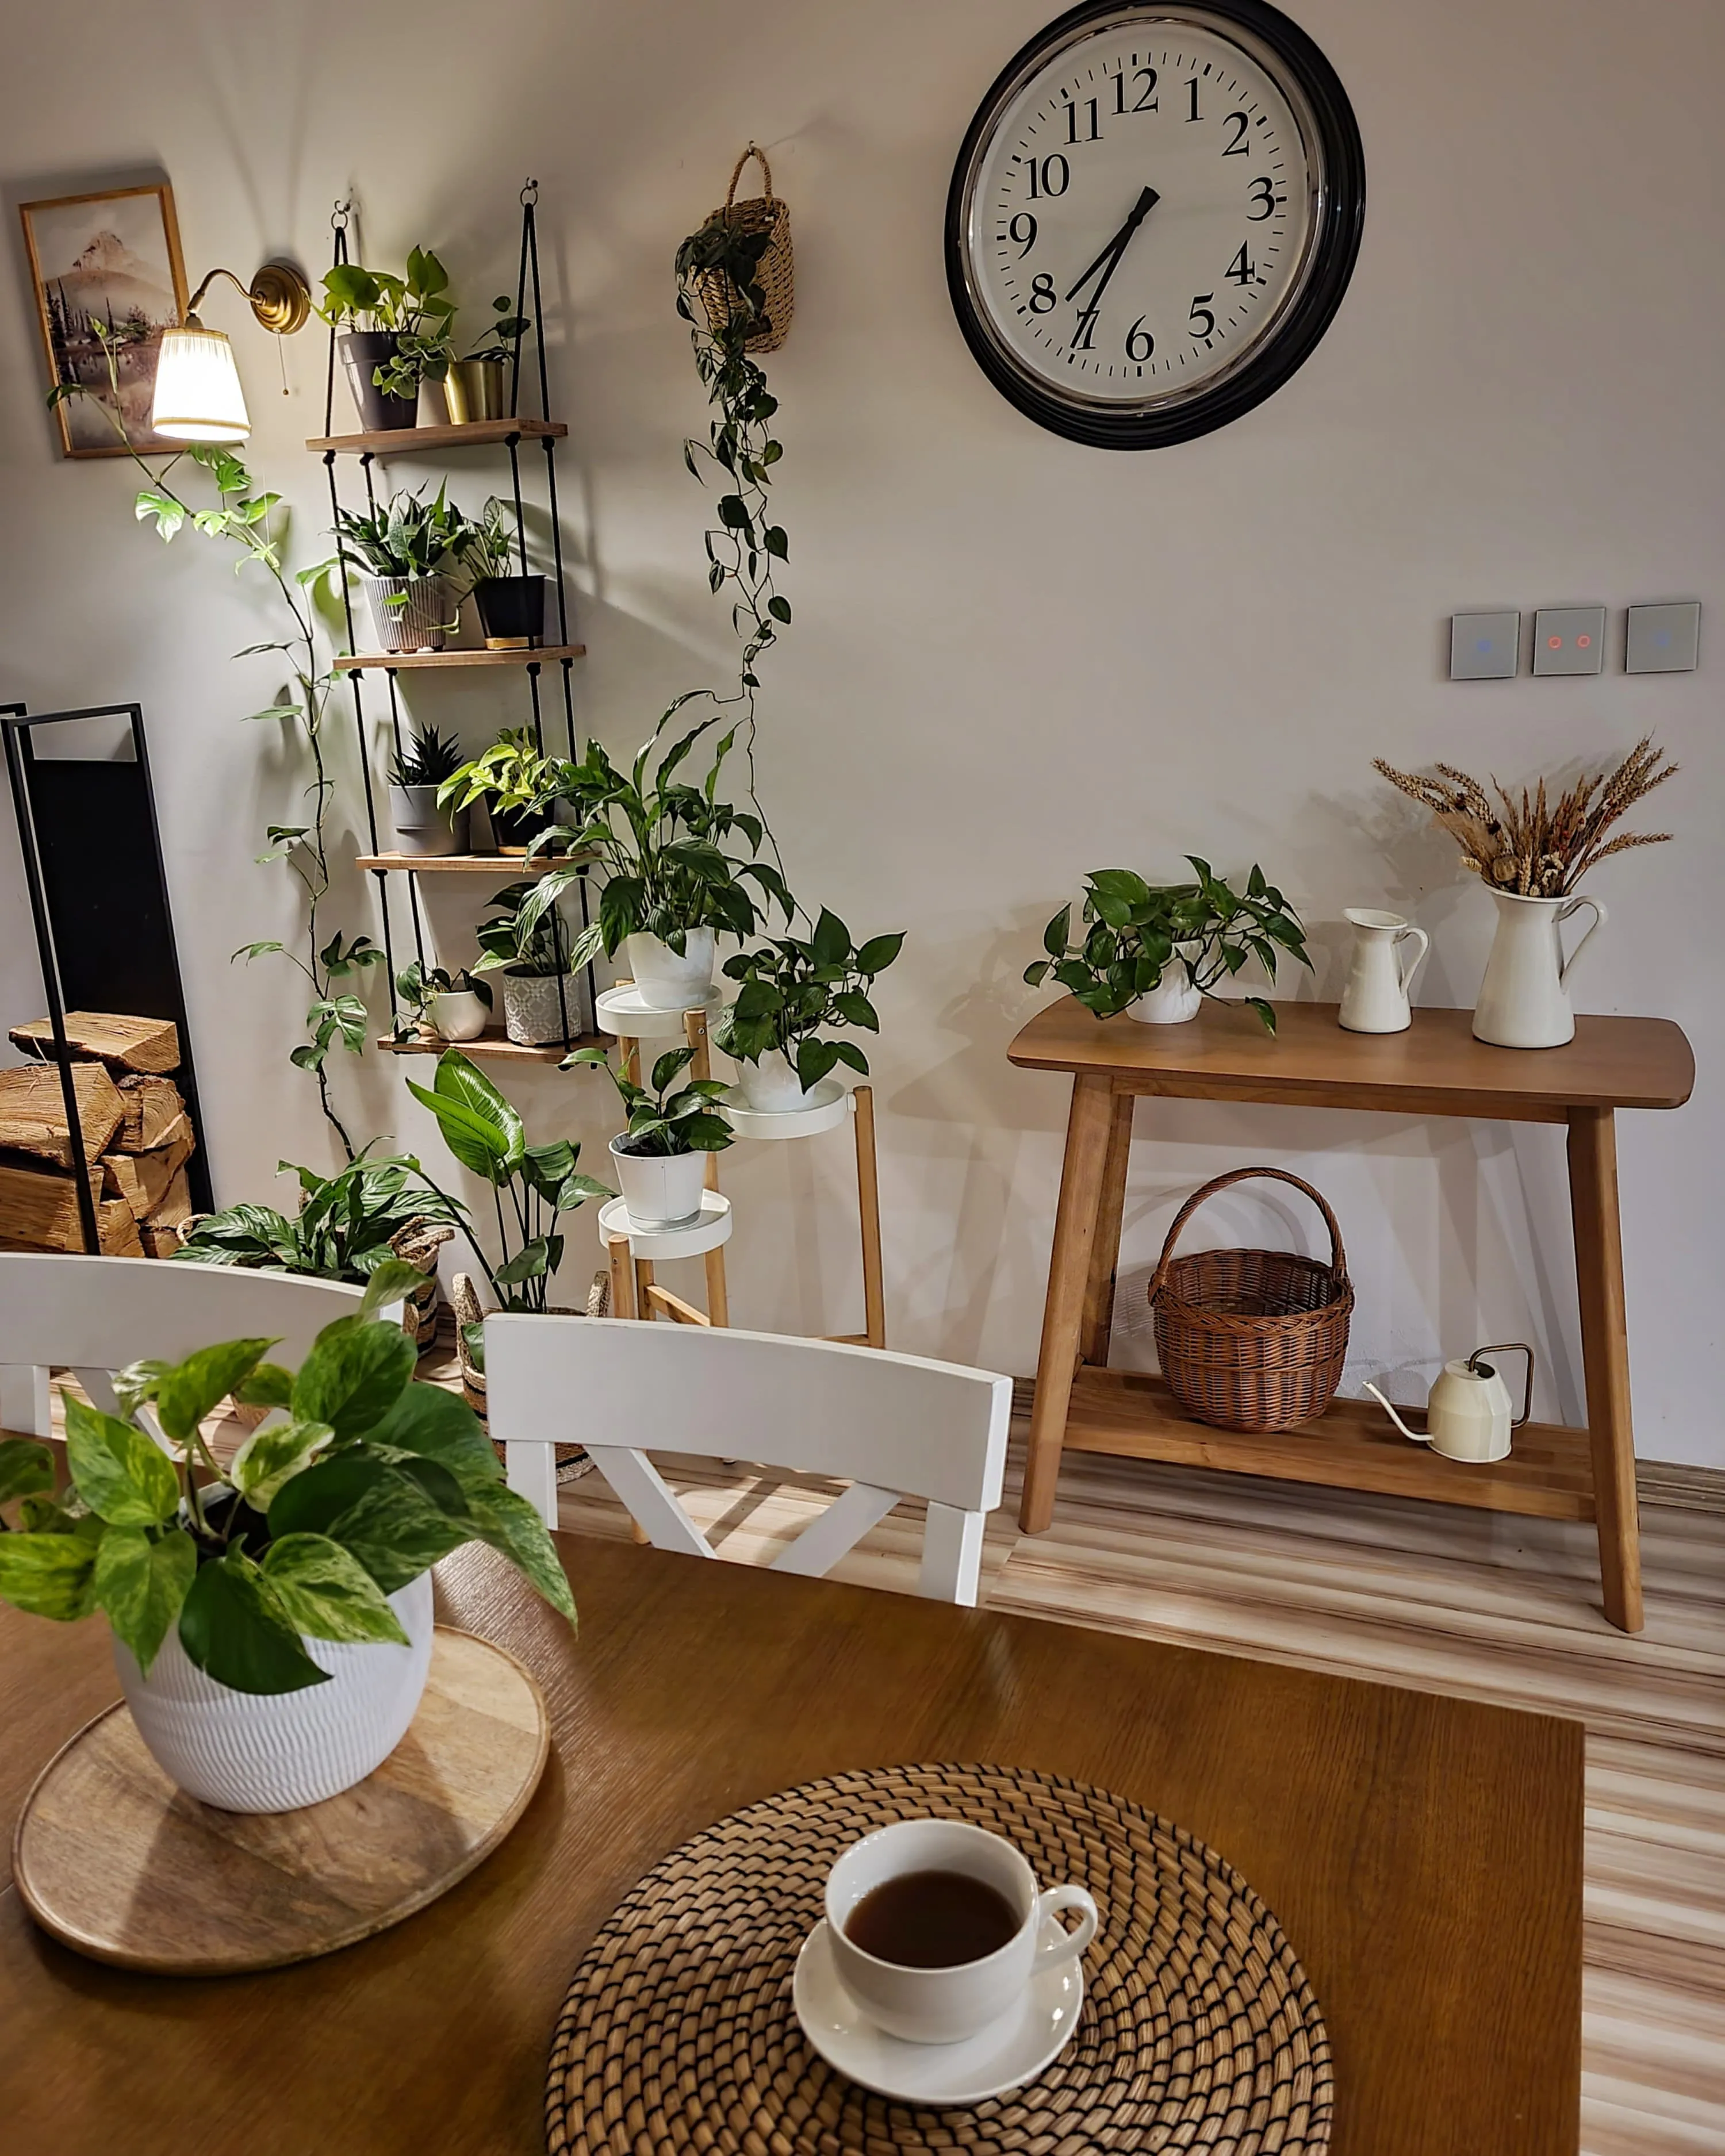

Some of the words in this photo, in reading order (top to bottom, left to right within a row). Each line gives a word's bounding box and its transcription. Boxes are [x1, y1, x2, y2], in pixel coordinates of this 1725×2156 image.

[1110, 68, 1159, 116] 12
[1183, 77, 1205, 123] 1
[1061, 97, 1104, 145] 11
[1221, 112, 1249, 157] 2
[1023, 154, 1070, 200] 10
[1246, 177, 1275, 221] 3
[1009, 212, 1037, 260] 9
[1224, 240, 1255, 286] 4
[1029, 273, 1057, 314] 8
[1188, 291, 1215, 338] 5
[1076, 308, 1101, 350] 7
[1125, 314, 1155, 362] 6
